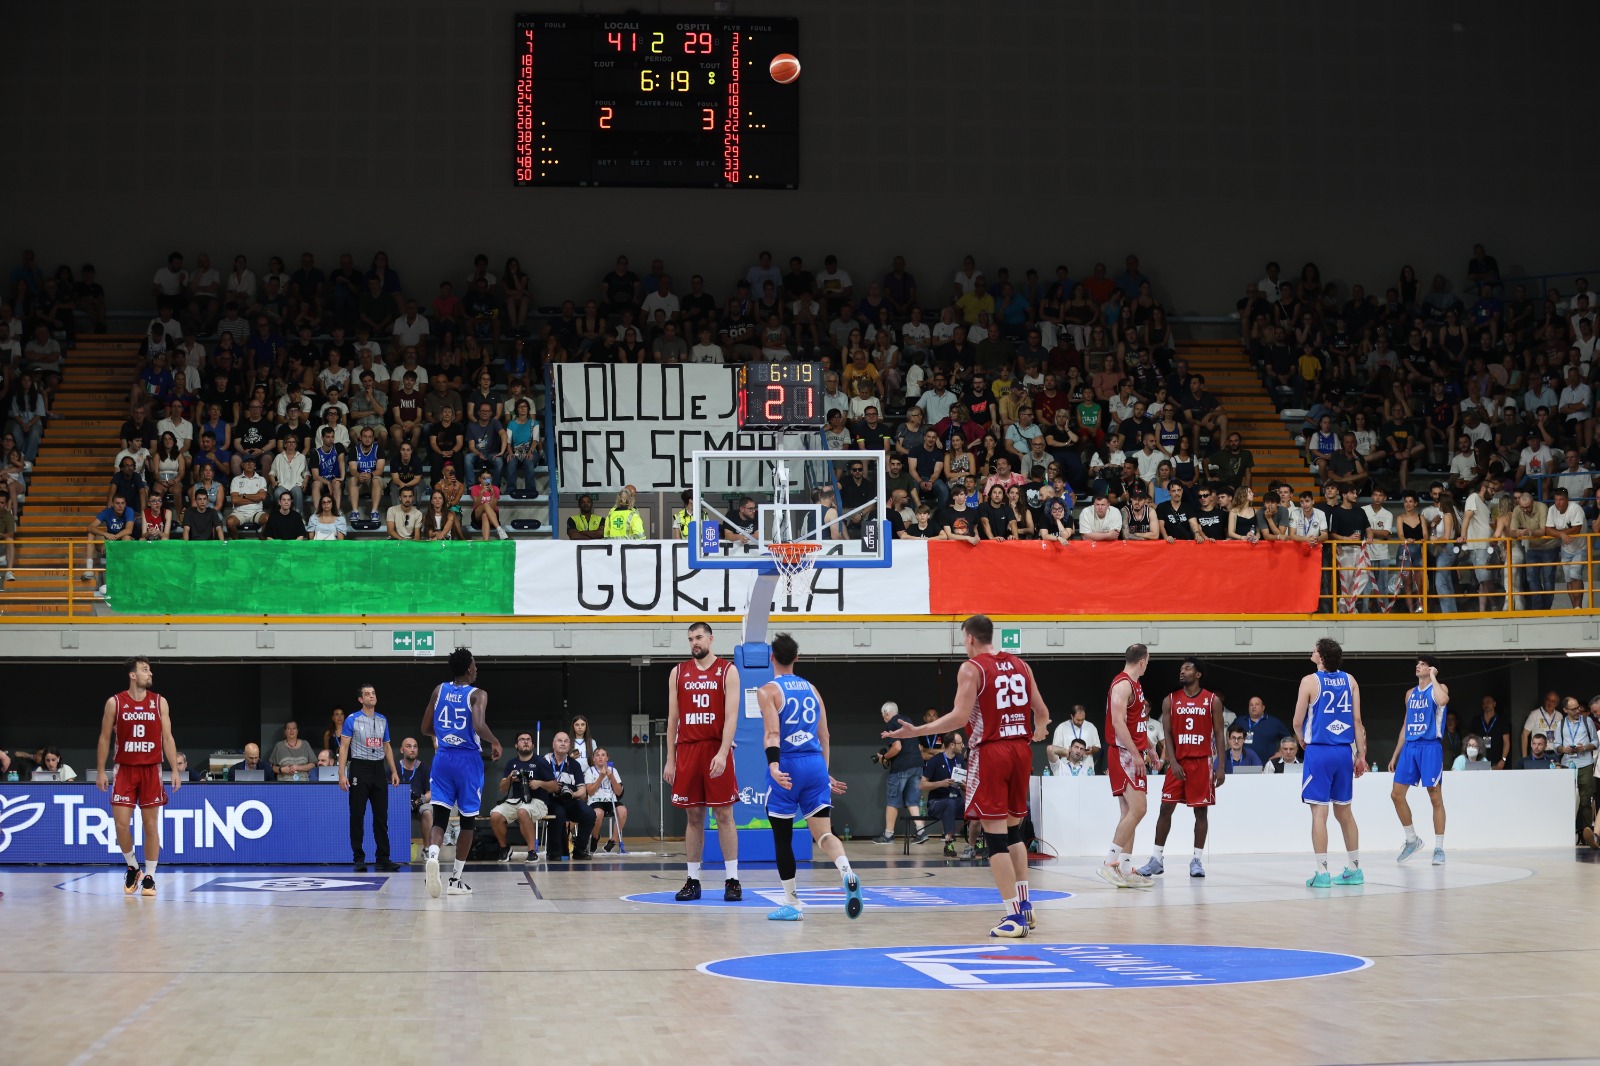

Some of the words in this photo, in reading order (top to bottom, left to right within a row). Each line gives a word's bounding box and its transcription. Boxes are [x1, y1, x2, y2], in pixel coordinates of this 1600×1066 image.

[604, 22, 639, 30] LOCALI
[676, 23, 710, 31] OSPITI
[525, 30, 533, 40] 4
[732, 32, 739, 44] 3
[526, 42, 533, 53] 7
[608, 32, 636, 52] 41
[652, 32, 664, 53] 2
[684, 32, 712, 54] 29
[732, 45, 739, 56] 5
[522, 54, 532, 66] 18
[732, 58, 739, 68] 8
[522, 67, 532, 78] 19
[732, 70, 739, 81] 9
[517, 80, 532, 92] 22
[641, 70, 690, 92] 6:19
[728, 83, 739, 94] 10
[517, 92, 532, 104] 24
[728, 96, 739, 106] 18
[517, 106, 532, 117] 25
[728, 108, 739, 118] 19
[517, 118, 532, 130] 28
[600, 108, 612, 128] 2
[703, 108, 714, 130] 3
[724, 120, 739, 132] 22
[517, 131, 532, 142] 38
[724, 134, 739, 144] 24
[516, 144, 532, 156] 45
[724, 146, 739, 158] 29
[516, 156, 532, 168] 48
[724, 158, 739, 170] 33
[516, 169, 532, 180] 50
[724, 171, 739, 182] 40
[770, 363, 812, 382] 6:19
[557, 363, 684, 422] LOLLO
[765, 385, 813, 420] 21
[558, 430, 624, 487] PER
[684, 681, 718, 690] CROATIA
[994, 674, 1028, 709] 29
[692, 694, 710, 707] 40
[1322, 690, 1352, 714] 24
[1410, 699, 1428, 708] ITALIA
[785, 696, 816, 724] 28
[1176, 707, 1206, 715] CROATIA
[122, 712, 156, 721] CROATIA
[438, 705, 466, 730] 45
[696, 713, 716, 725] HEP
[1414, 713, 1424, 722] 19
[1185, 718, 1194, 730] 3
[133, 724, 145, 738] 18
[791, 734, 808, 743] IBSA
[1185, 734, 1204, 745] HEP
[134, 741, 155, 752] HEP
